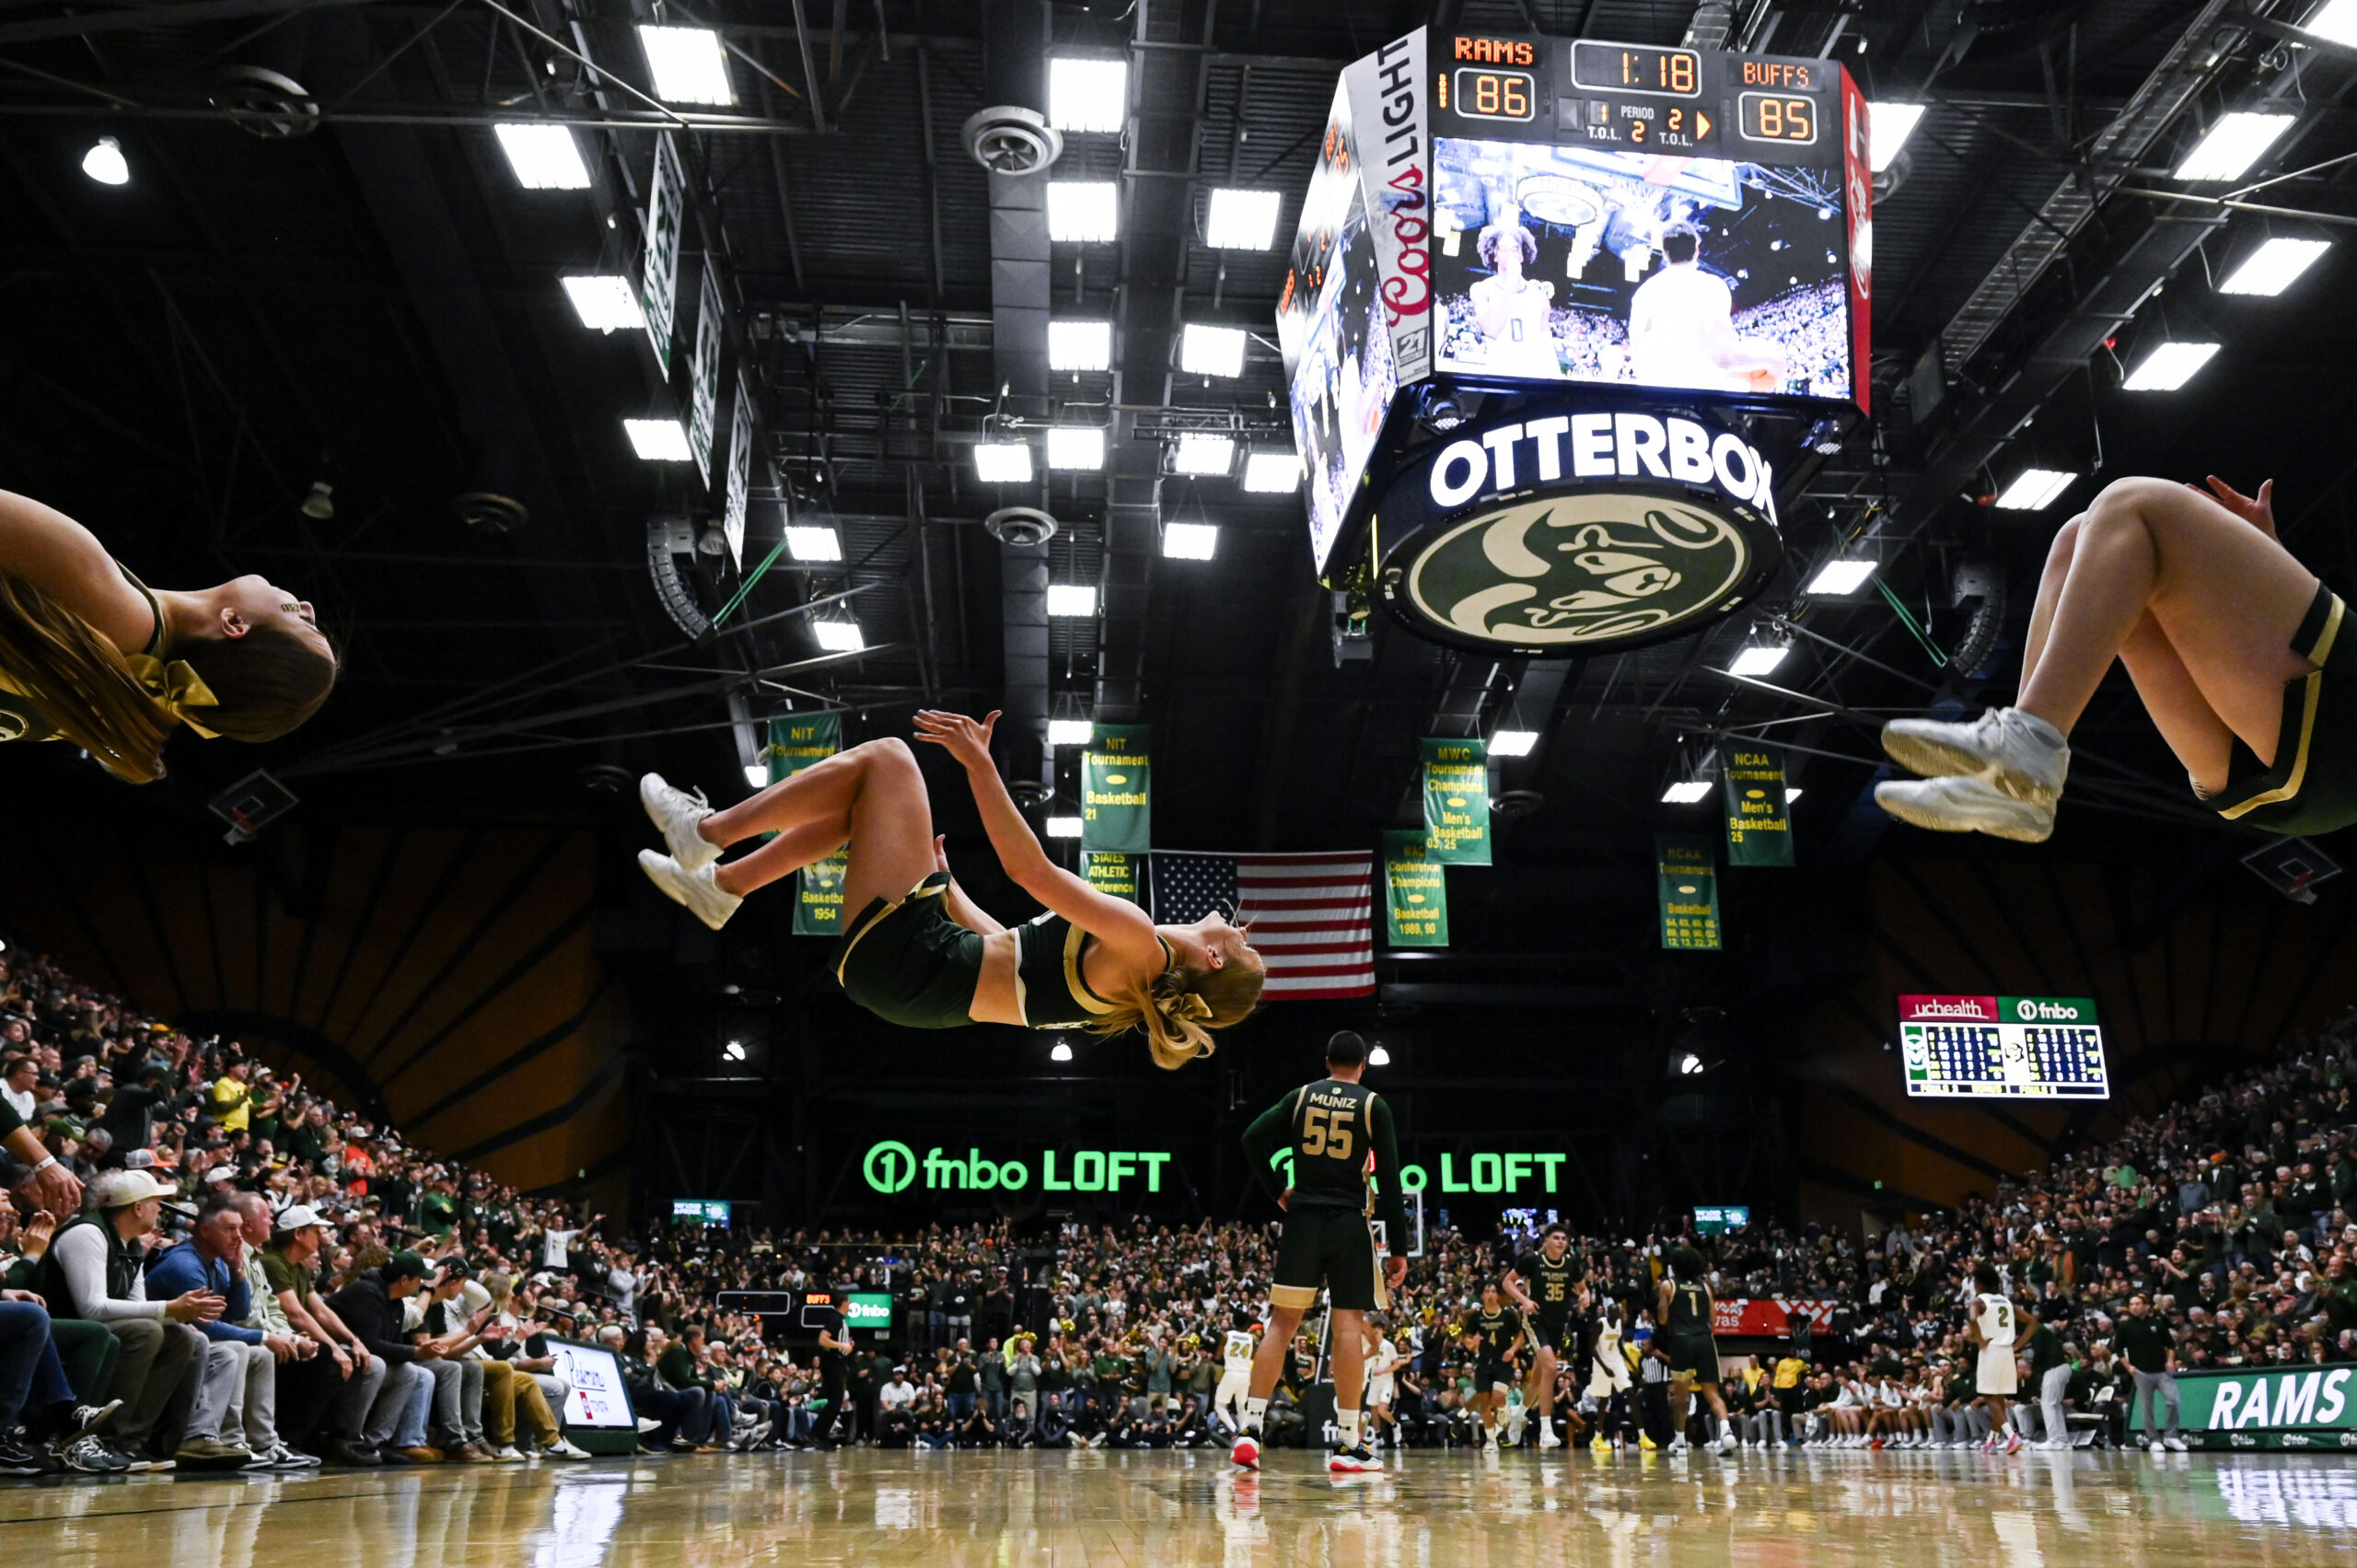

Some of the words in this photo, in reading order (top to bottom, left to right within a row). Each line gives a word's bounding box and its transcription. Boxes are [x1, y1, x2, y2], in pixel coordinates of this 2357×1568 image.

[1455, 36, 1534, 65] RAMS
[1743, 61, 1810, 89] BUFFS
[1377, 39, 1420, 167] LIGHT
[1476, 75, 1527, 116] 86
[1620, 105, 1655, 120] PERIOD
[1667, 108, 1683, 131] 2
[1759, 99, 1811, 140] 85
[1587, 126, 1621, 141] T.O.L.
[1631, 121, 1646, 144] 2
[1658, 132, 1693, 146] T.O.L.
[1381, 163, 1428, 329] Coors
[1430, 412, 1779, 527] OTTERBOX
[791, 726, 815, 740] NIT
[771, 743, 836, 758] Tournament
[1106, 738, 1127, 750] NIT
[1086, 752, 1149, 766] Tournament
[1438, 748, 1470, 761] MWC
[1735, 753, 1769, 766] NCAA
[1426, 761, 1485, 777] Tournament
[1723, 767, 1785, 782] Tournament
[1428, 778, 1484, 795] Champions
[1086, 790, 1146, 806] Basketball
[1085, 807, 1097, 820] 21
[1741, 800, 1773, 814] Men's
[1443, 811, 1471, 826] Men's
[1730, 817, 1787, 831] Basketball
[1433, 825, 1482, 840] Basketball
[1731, 831, 1744, 842] 25
[1444, 838, 1457, 851] 25
[1088, 865, 1130, 878] ATHLETIC
[1389, 876, 1441, 890] Champions
[1394, 906, 1440, 920] Basketball
[1915, 999, 1982, 1016] uchealth
[2038, 1002, 2078, 1019] fnbo
[1309, 1092, 1358, 1109] MUNIZ
[1302, 1106, 1355, 1160] 55
[923, 1148, 1028, 1190] fnbo
[1043, 1151, 1171, 1192] LOFT
[1440, 1152, 1567, 1193] LOFT
[1544, 1283, 1565, 1302] 35
[862, 1304, 890, 1318] fnbo
[1689, 1291, 1699, 1317] 1
[1998, 1306, 2009, 1328] 2
[1228, 1342, 1250, 1359] 24
[2207, 1368, 2352, 1430] RAMS
